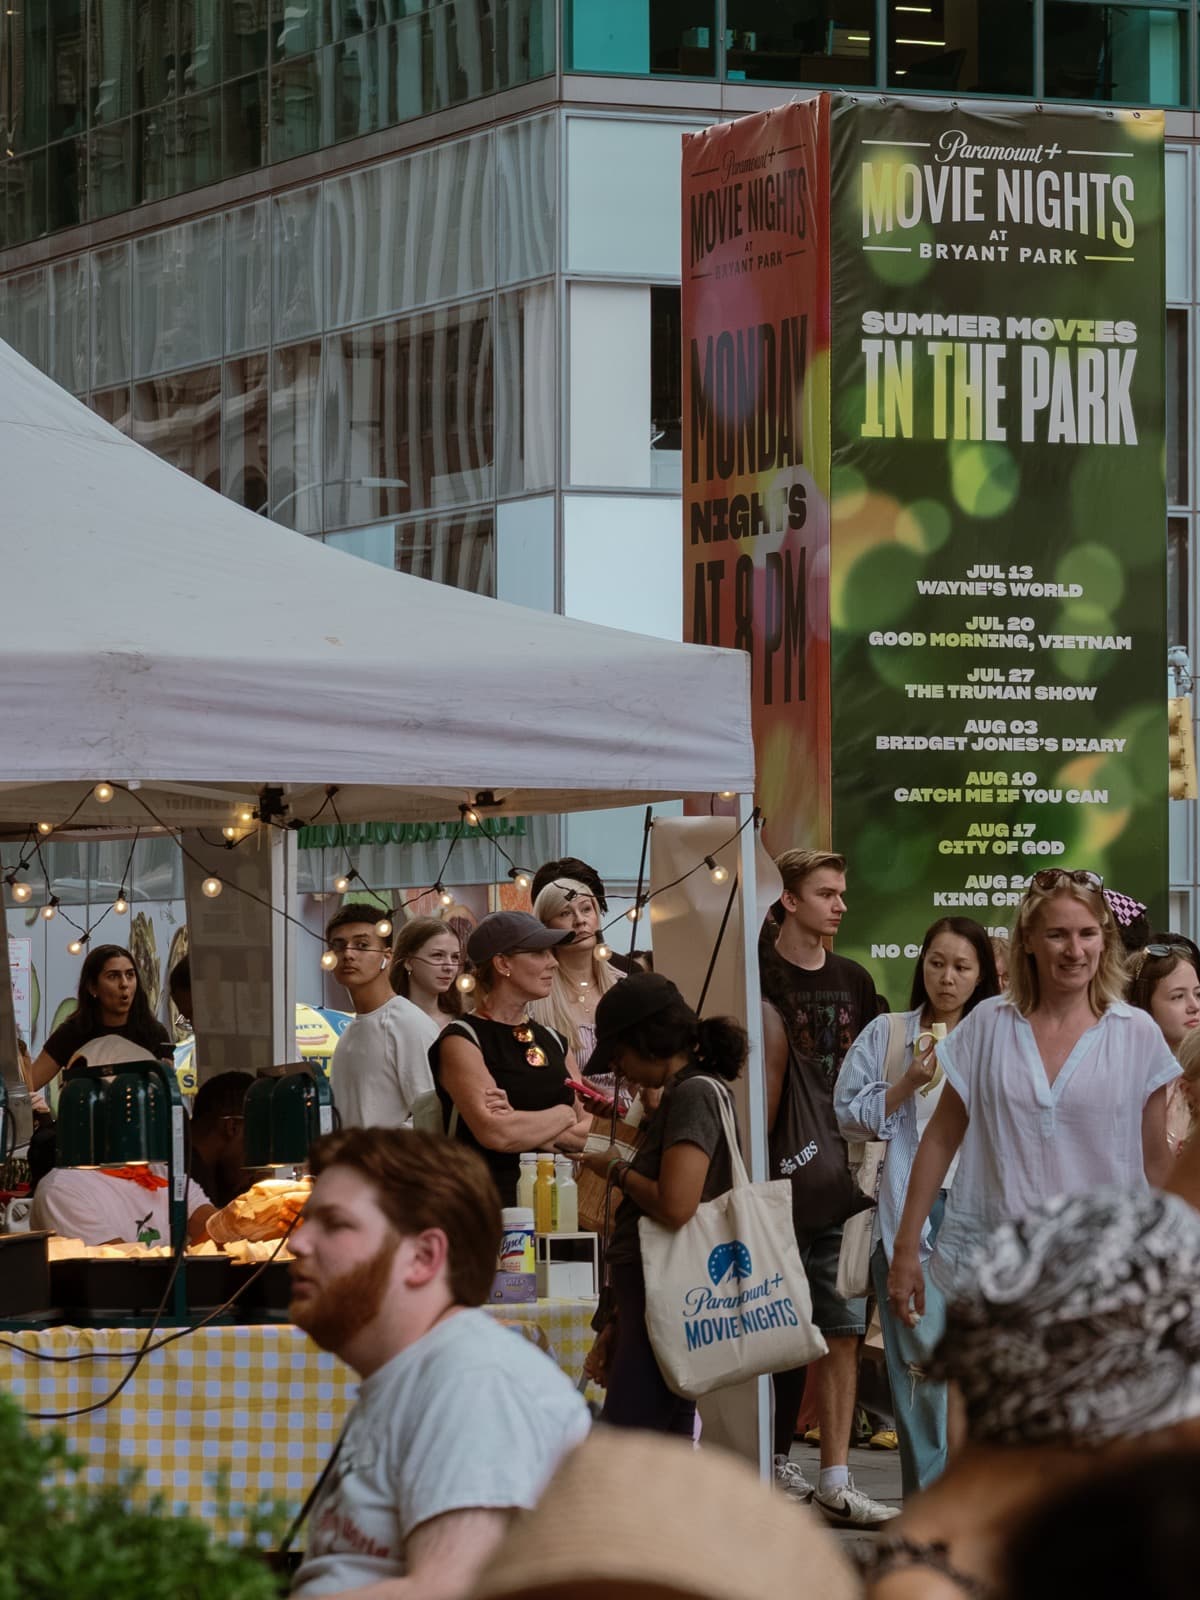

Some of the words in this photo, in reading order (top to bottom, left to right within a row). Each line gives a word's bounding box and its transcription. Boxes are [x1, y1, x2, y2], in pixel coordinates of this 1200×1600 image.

[934, 129, 1063, 164] Paramount+
[720, 146, 776, 184] Paramount+
[861, 162, 985, 238] MOVIE
[997, 169, 1135, 249] NIGHTS
[690, 183, 743, 269] MOVIE
[748, 167, 807, 240] NIGHTS
[989, 229, 1008, 242] AT
[744, 240, 753, 253] AT
[919, 242, 1010, 262] BRYANT
[1019, 247, 1078, 265] PARK
[715, 258, 753, 280] BRYANT
[758, 251, 783, 270] PARK
[861, 311, 1001, 338] SUMMER
[1006, 317, 1138, 344] MOVIES
[690, 314, 809, 484] MONDAY
[861, 339, 914, 439] IN
[928, 342, 1007, 441] THE
[1020, 346, 1138, 446] PARK
[691, 484, 807, 544] NIGHTS
[966, 564, 1005, 580] JUL
[1009, 565, 1034, 580] 13
[1010, 582, 1083, 598] WORLD
[765, 547, 806, 705] PM
[966, 616, 1005, 631] JUL
[1008, 617, 1035, 632] 20
[869, 631, 926, 647] GOOD
[930, 633, 1035, 652] MORNING,
[1038, 634, 1132, 651] VIETNAM
[967, 668, 1005, 682] JUL
[1009, 669, 1035, 683] 27
[905, 683, 945, 699] THE
[947, 684, 1031, 700] TRUMAN
[1034, 686, 1098, 701] SHOW
[964, 719, 1006, 735] AUG
[1010, 720, 1038, 735] 03
[876, 735, 968, 752] BRIDGET
[1062, 738, 1126, 754] DIARY
[966, 771, 1008, 786] AUG
[1011, 771, 1037, 786] 10
[894, 787, 962, 803] CATCH
[965, 788, 993, 803] ME
[996, 788, 1020, 803] IF
[1022, 789, 1062, 804] YOU
[1065, 789, 1109, 805] CAN
[967, 823, 1009, 838] AUG
[1012, 823, 1037, 838] 17
[938, 840, 988, 855] CITY
[991, 840, 1019, 855] OF
[1022, 841, 1065, 856] GOD
[965, 874, 1008, 890] AUG
[933, 892, 988, 907] KING
[871, 943, 905, 959] NO
[795, 1140, 819, 1167] UBS
[682, 1272, 784, 1318] Paramount+
[684, 1316, 741, 1353] MOVIE
[740, 1297, 799, 1335] NIGHTS
